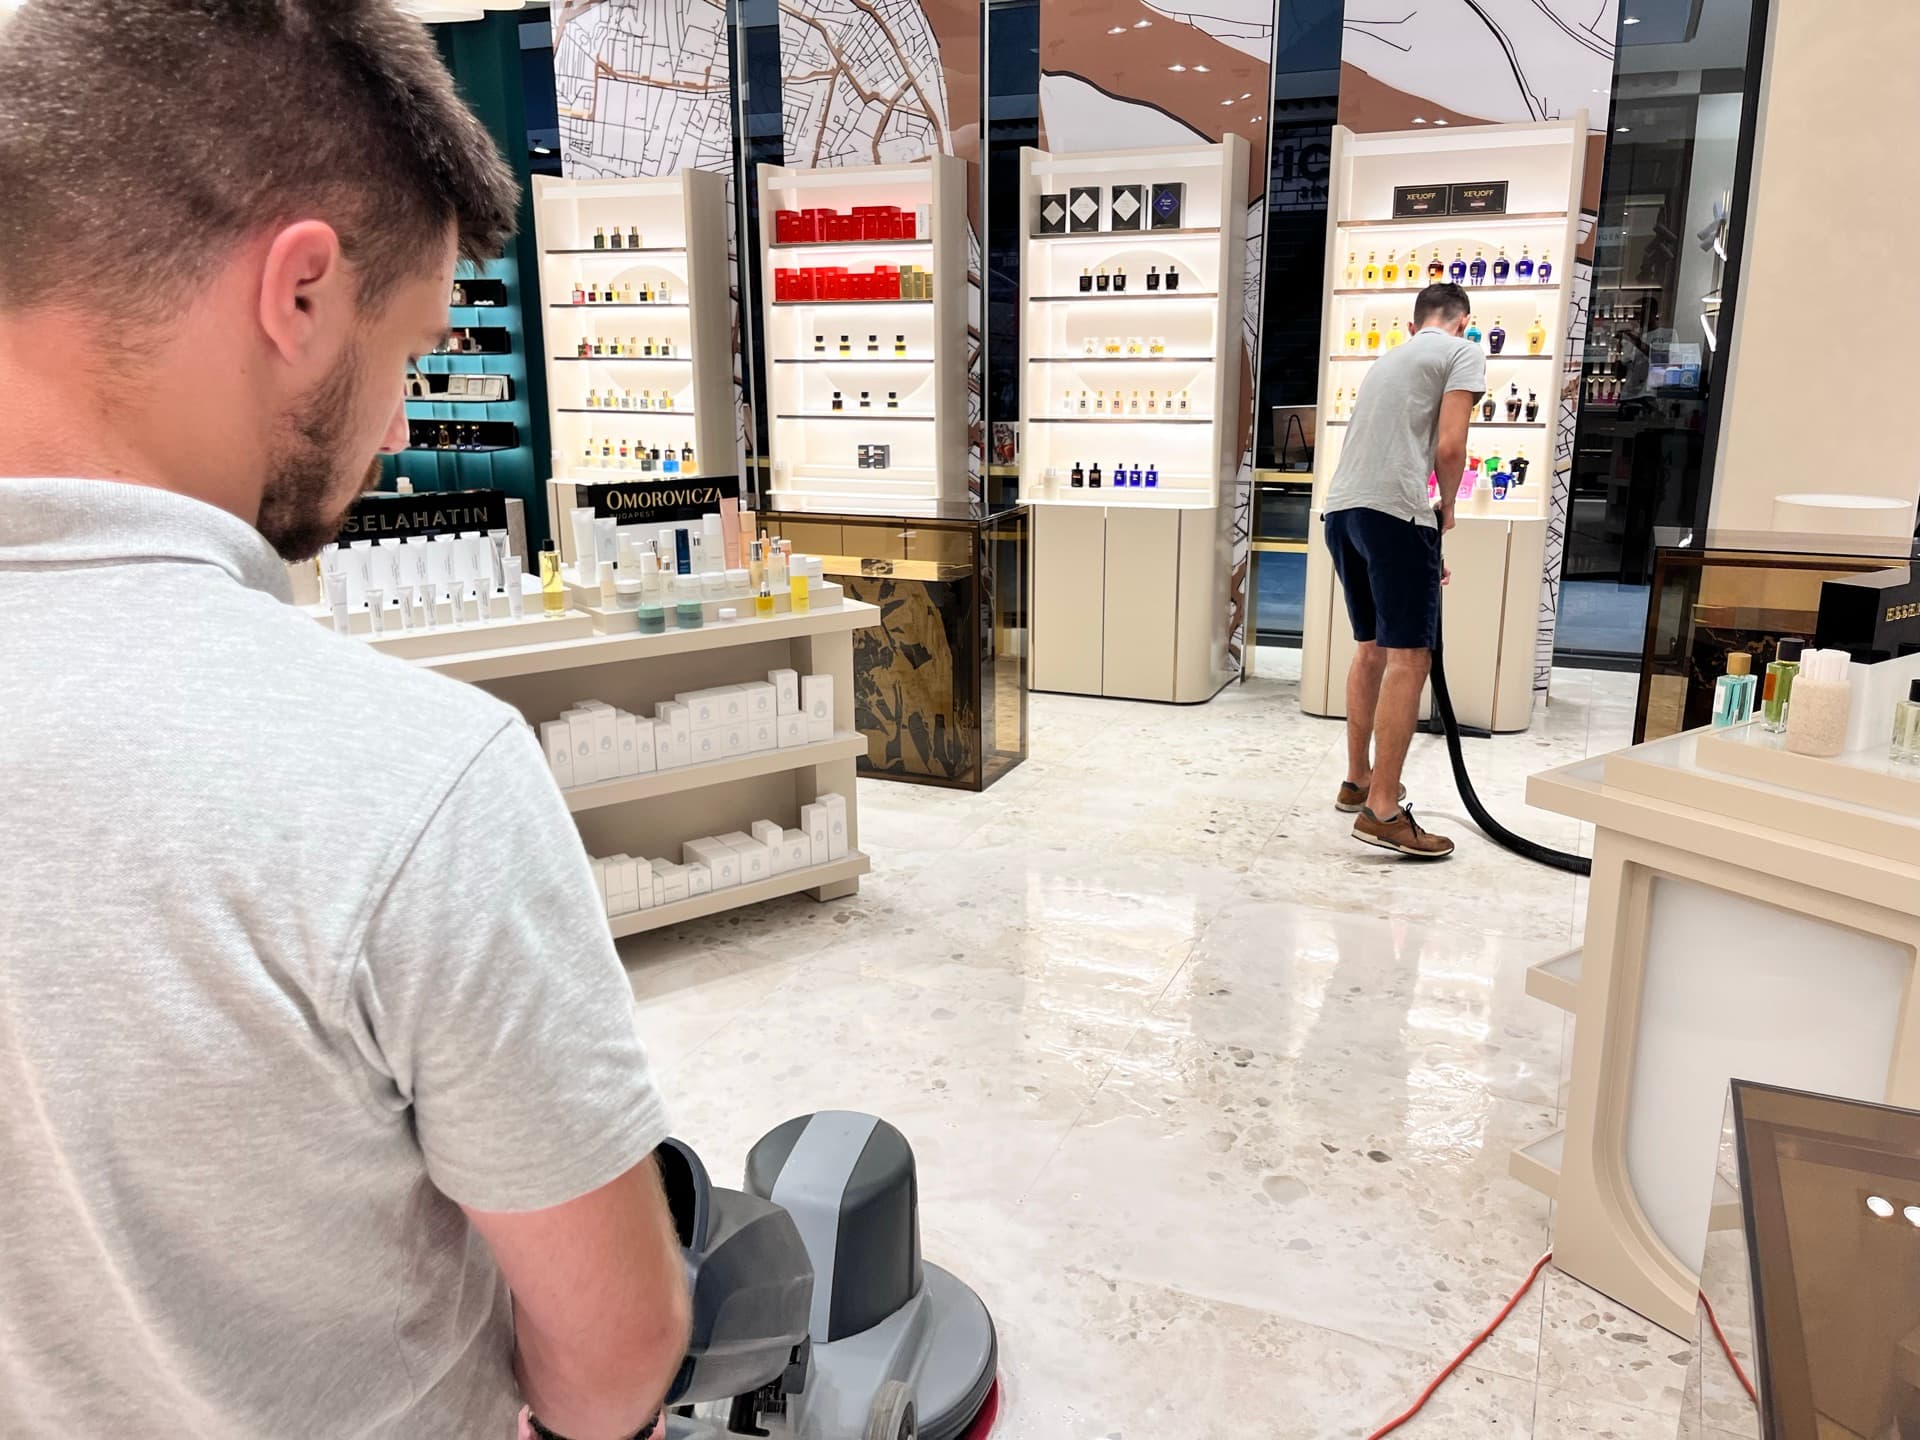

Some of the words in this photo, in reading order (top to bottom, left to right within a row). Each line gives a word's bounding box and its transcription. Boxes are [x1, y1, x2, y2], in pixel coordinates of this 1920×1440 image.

[1407, 192, 1437, 201] XERJOFF
[1463, 189, 1494, 198] XERJOFF
[606, 488, 723, 511] OMOROVICZA
[344, 506, 489, 533] SELAHATIN
